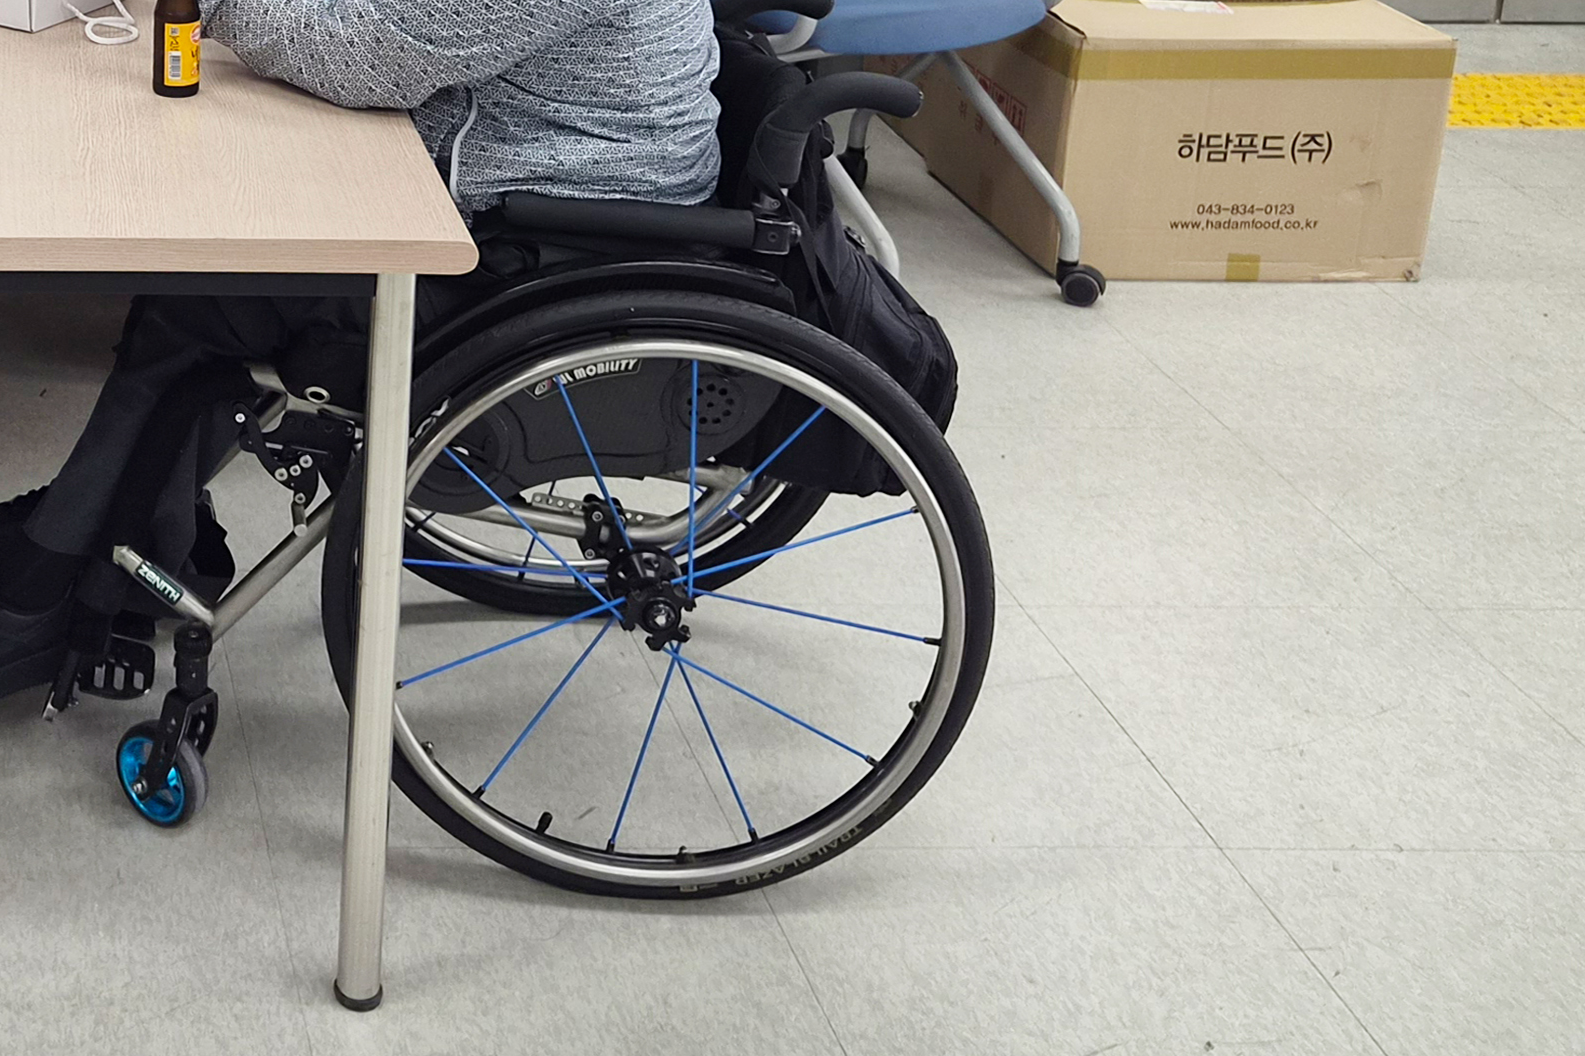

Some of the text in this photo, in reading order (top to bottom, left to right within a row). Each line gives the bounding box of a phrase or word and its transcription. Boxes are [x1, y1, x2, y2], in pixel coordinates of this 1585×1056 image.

[1195, 203, 1296, 216] 043-834-0123
[1169, 218, 1319, 232] www.hadamfood.co.kr
[573, 358, 638, 380] MOBILITY
